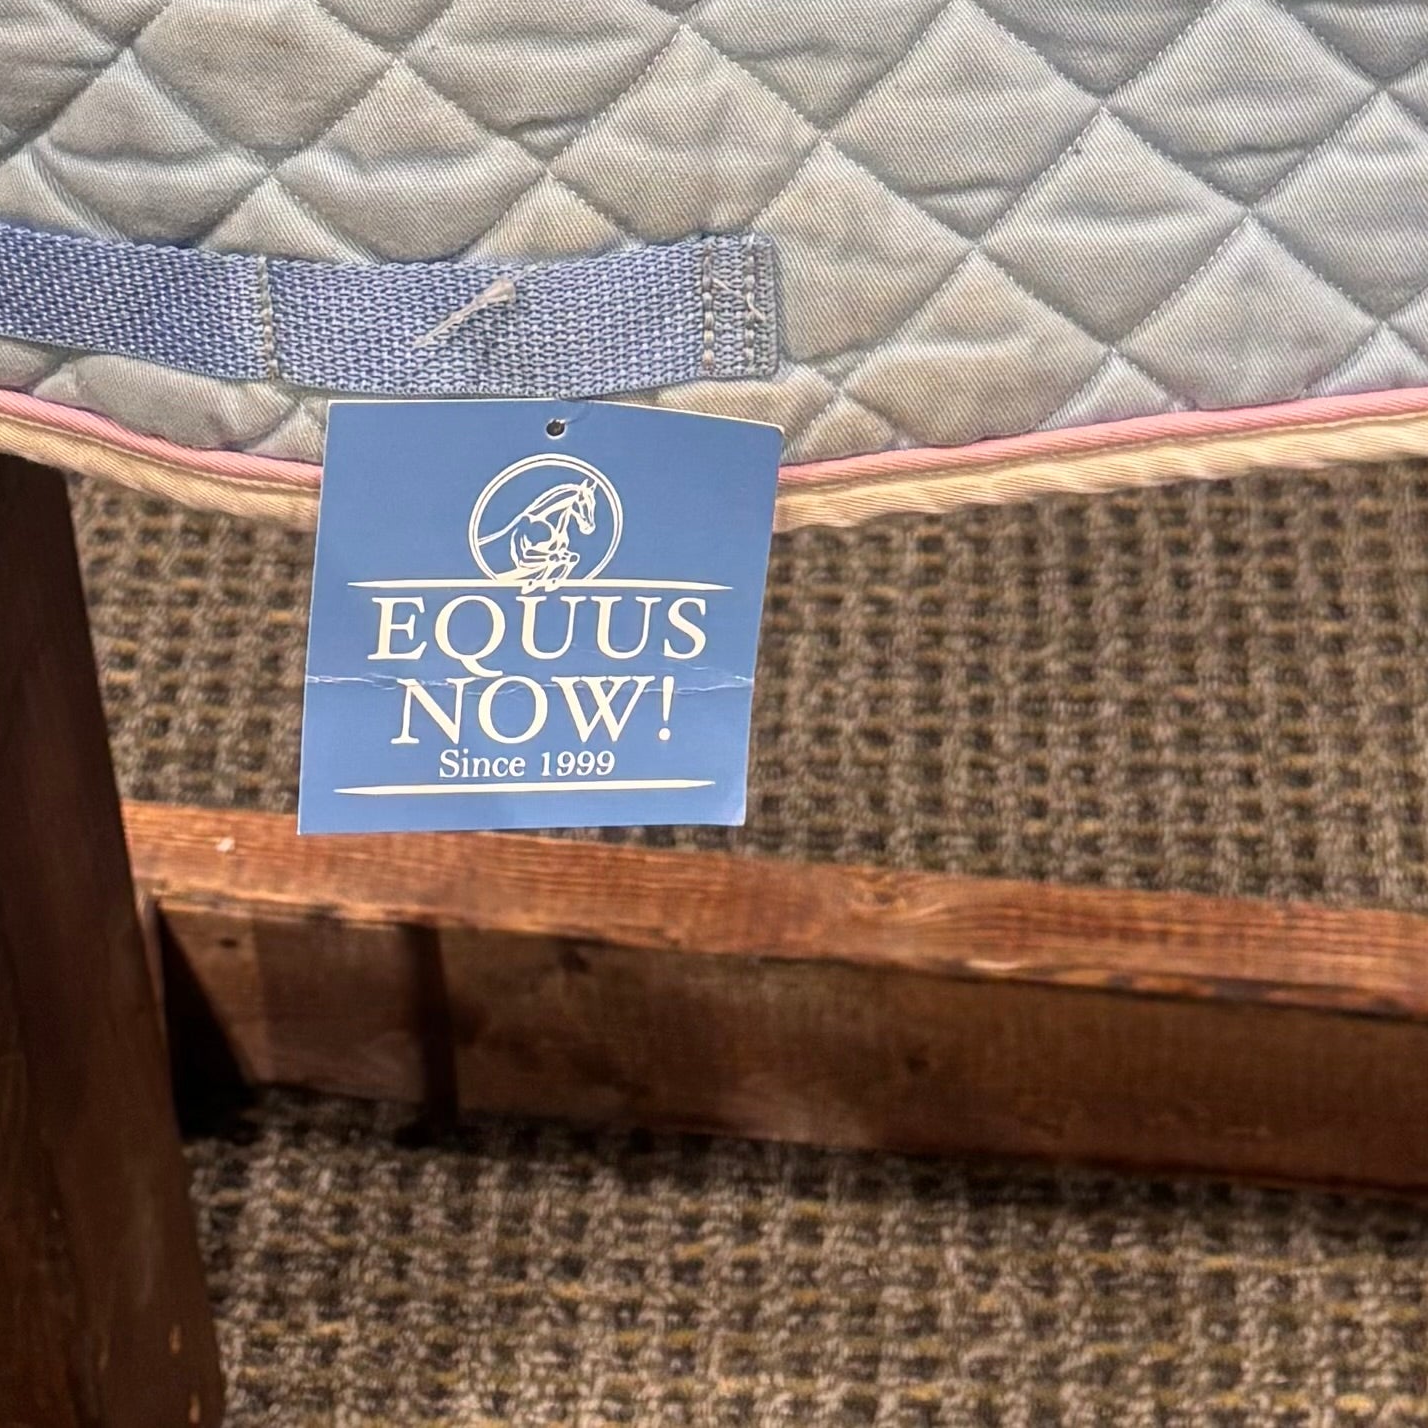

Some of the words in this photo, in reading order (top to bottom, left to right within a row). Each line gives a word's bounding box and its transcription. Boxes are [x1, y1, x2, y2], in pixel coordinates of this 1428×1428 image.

[367, 595, 707, 678] EQUUS
[390, 675, 675, 744] NOW!
[438, 748, 526, 779] Since
[540, 750, 615, 777] 1999
